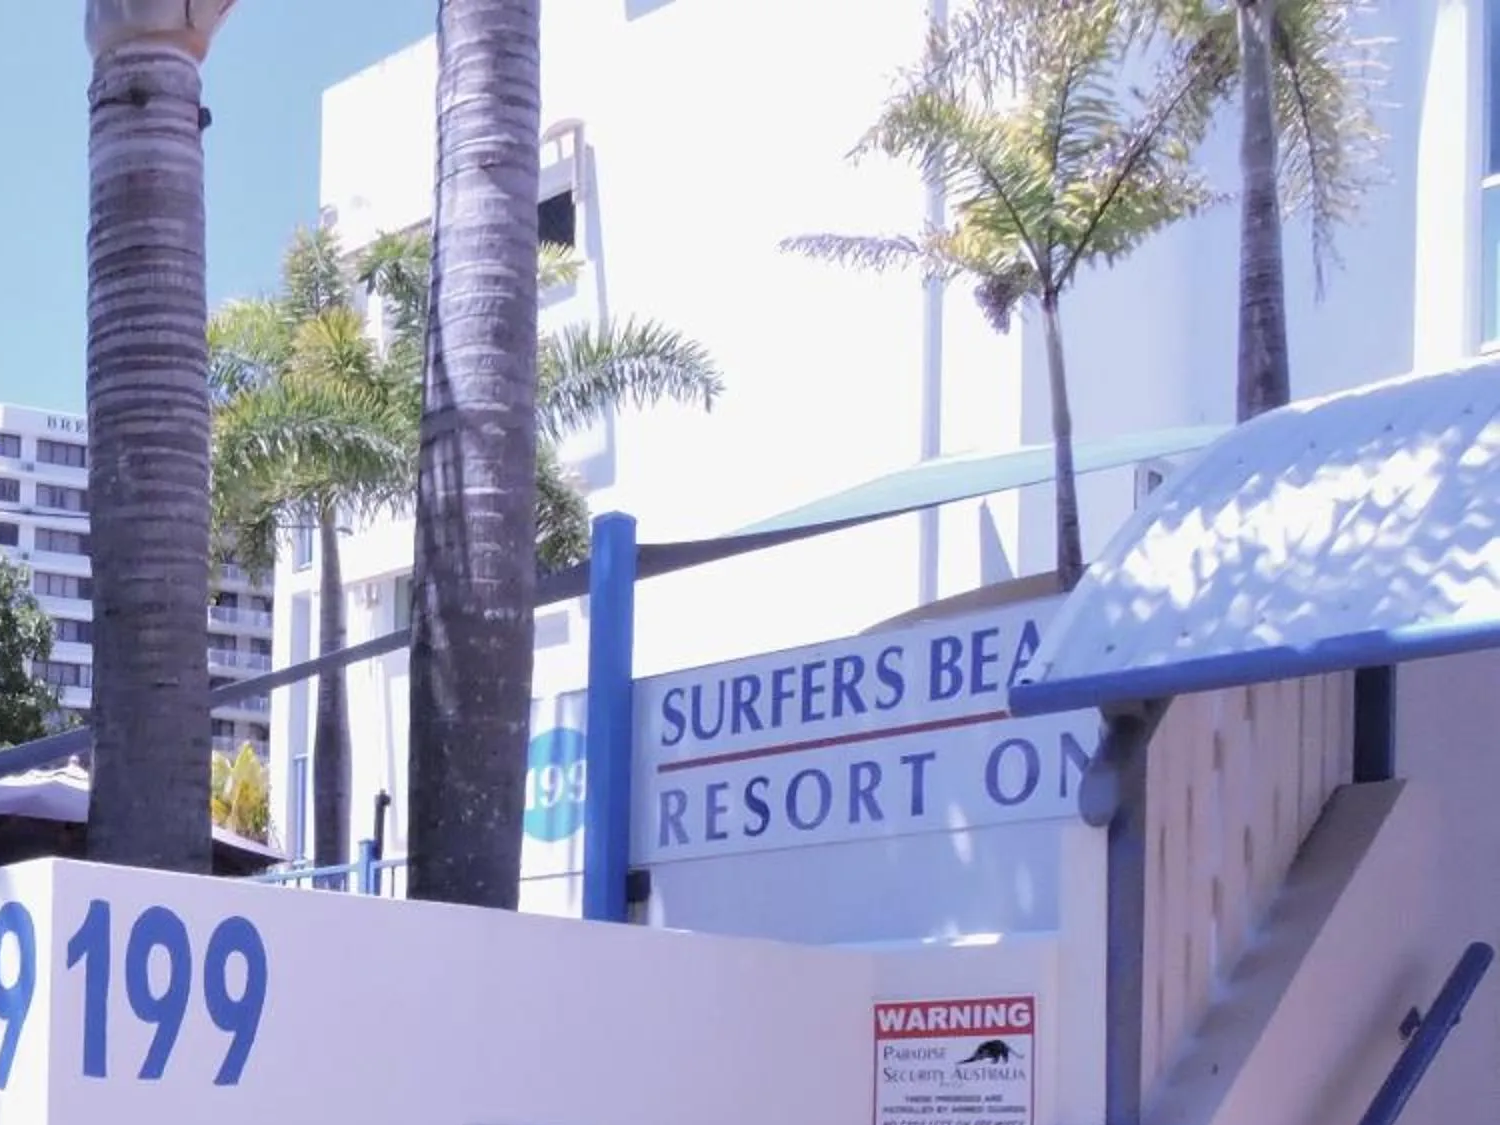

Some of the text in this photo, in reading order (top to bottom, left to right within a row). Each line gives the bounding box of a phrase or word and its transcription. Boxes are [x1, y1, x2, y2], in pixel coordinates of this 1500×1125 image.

[661, 645, 905, 746] SURFERS
[658, 752, 936, 849] RESORT
[67, 899, 268, 1086] 199
[877, 1002, 1032, 1032] WARNING
[883, 1065, 1027, 1083] SECURITY AUSTRALIA
